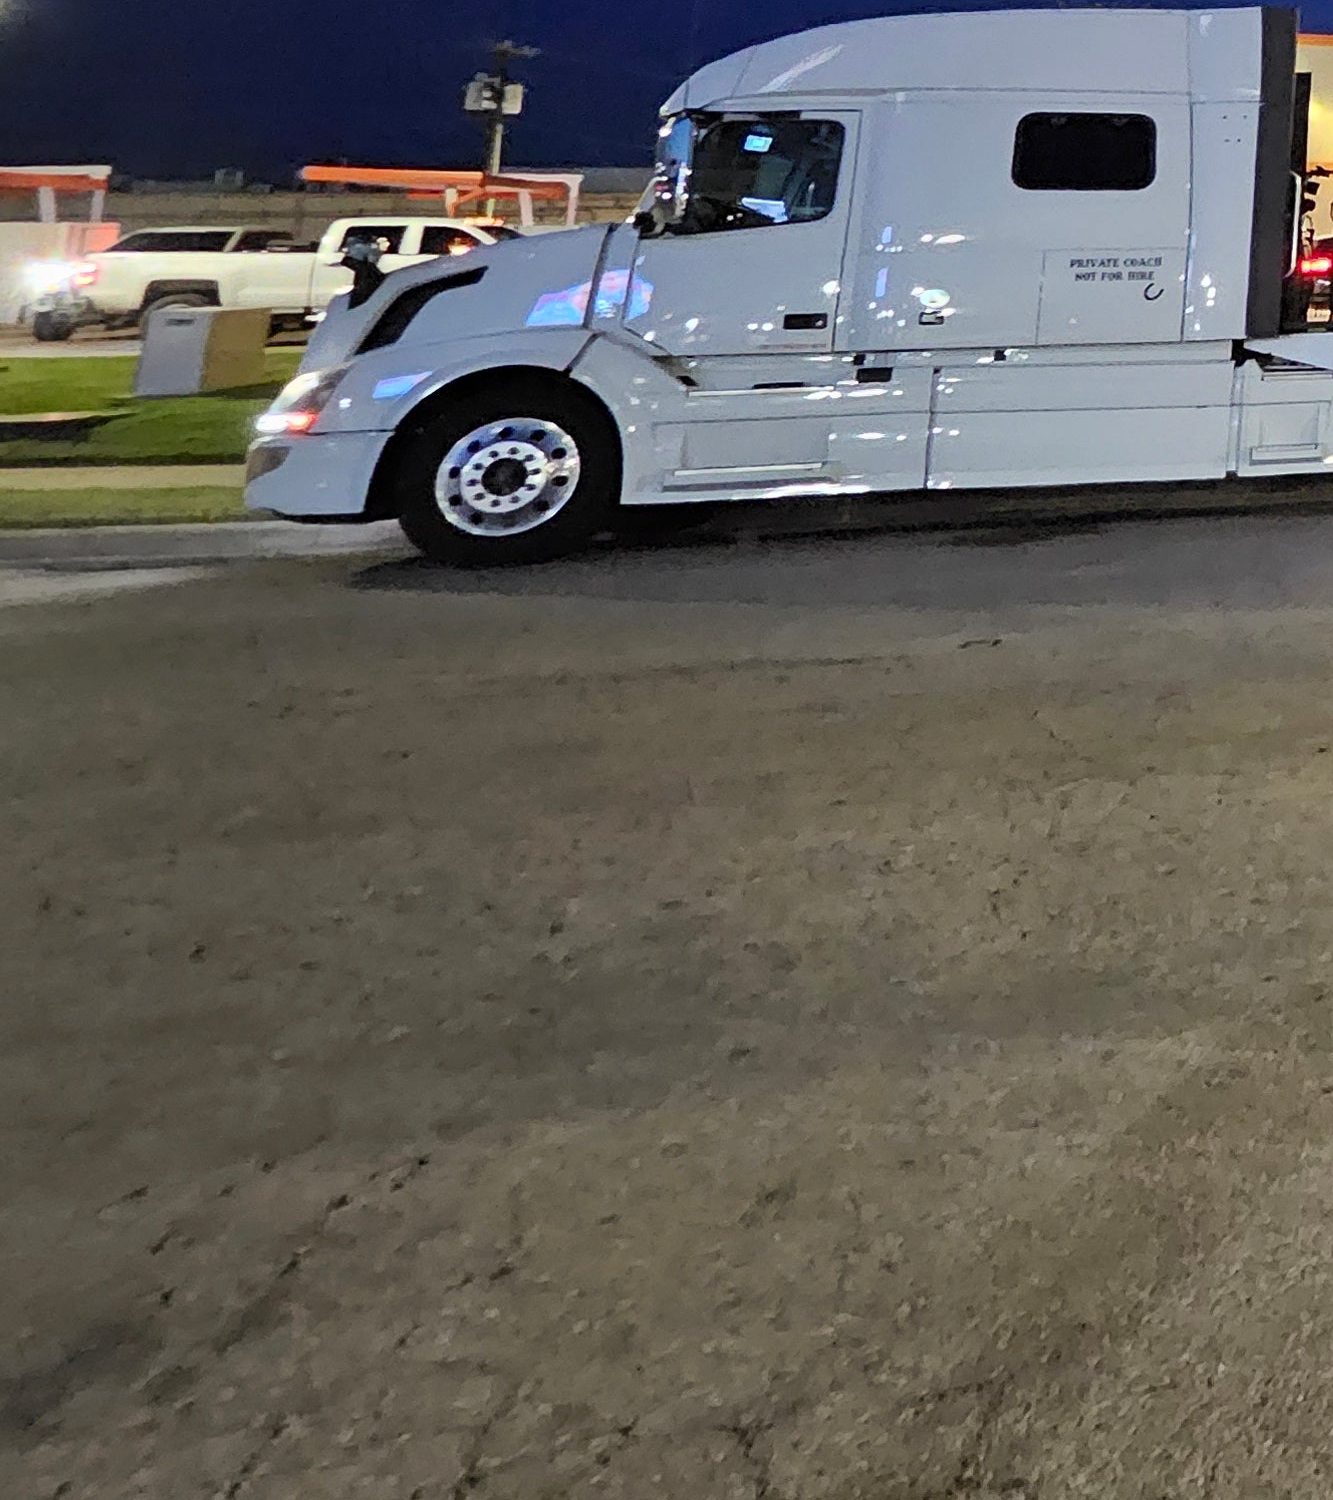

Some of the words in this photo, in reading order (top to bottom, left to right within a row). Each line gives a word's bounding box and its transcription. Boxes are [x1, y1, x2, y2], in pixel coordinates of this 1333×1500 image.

[1070, 258, 1120, 268] PRIVATE
[1123, 257, 1162, 267] COACH
[1075, 271, 1096, 281] NOT
[1101, 271, 1123, 281] FOR
[1128, 270, 1155, 281] HIRE
